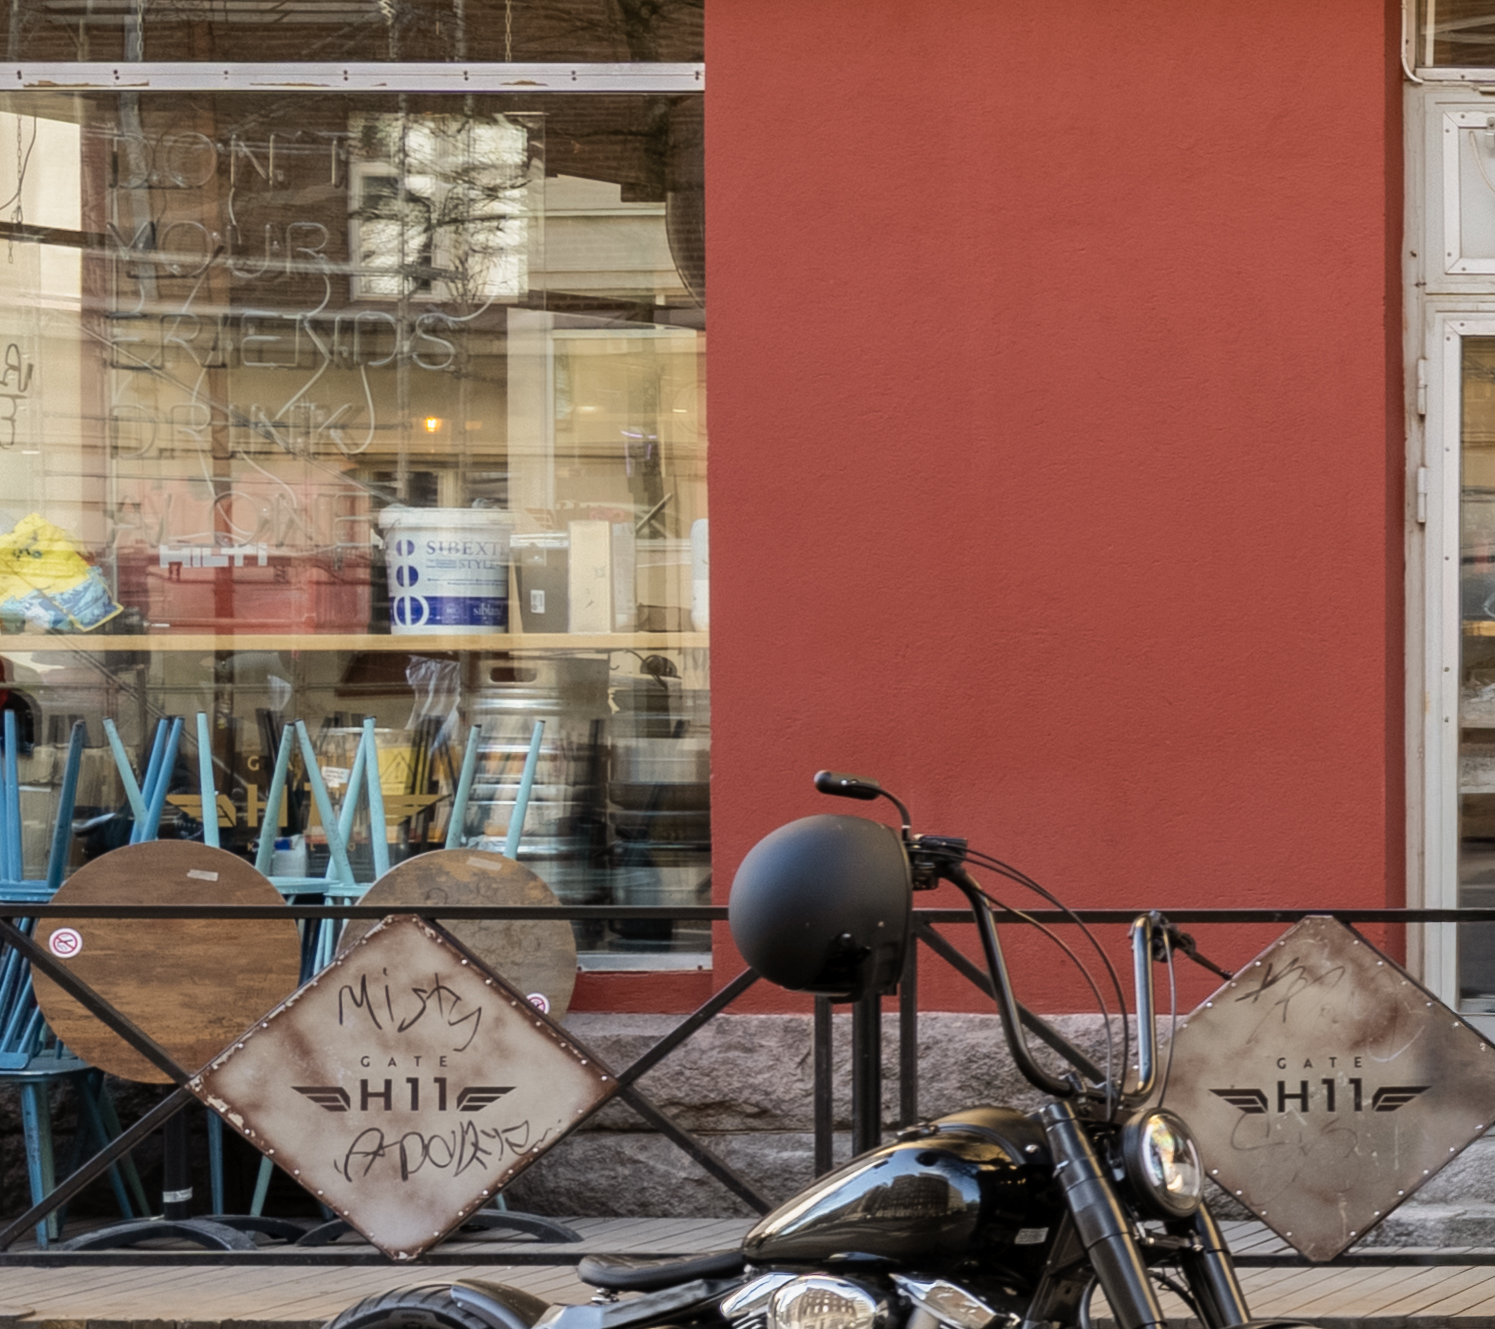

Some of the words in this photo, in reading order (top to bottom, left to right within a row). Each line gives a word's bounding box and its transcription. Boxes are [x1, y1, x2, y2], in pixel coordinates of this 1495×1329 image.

[360, 1056, 448, 1067] GATE
[1276, 1057, 1363, 1069] GATE
[360, 1077, 447, 1111] H11
[1277, 1078, 1363, 1113] H11
